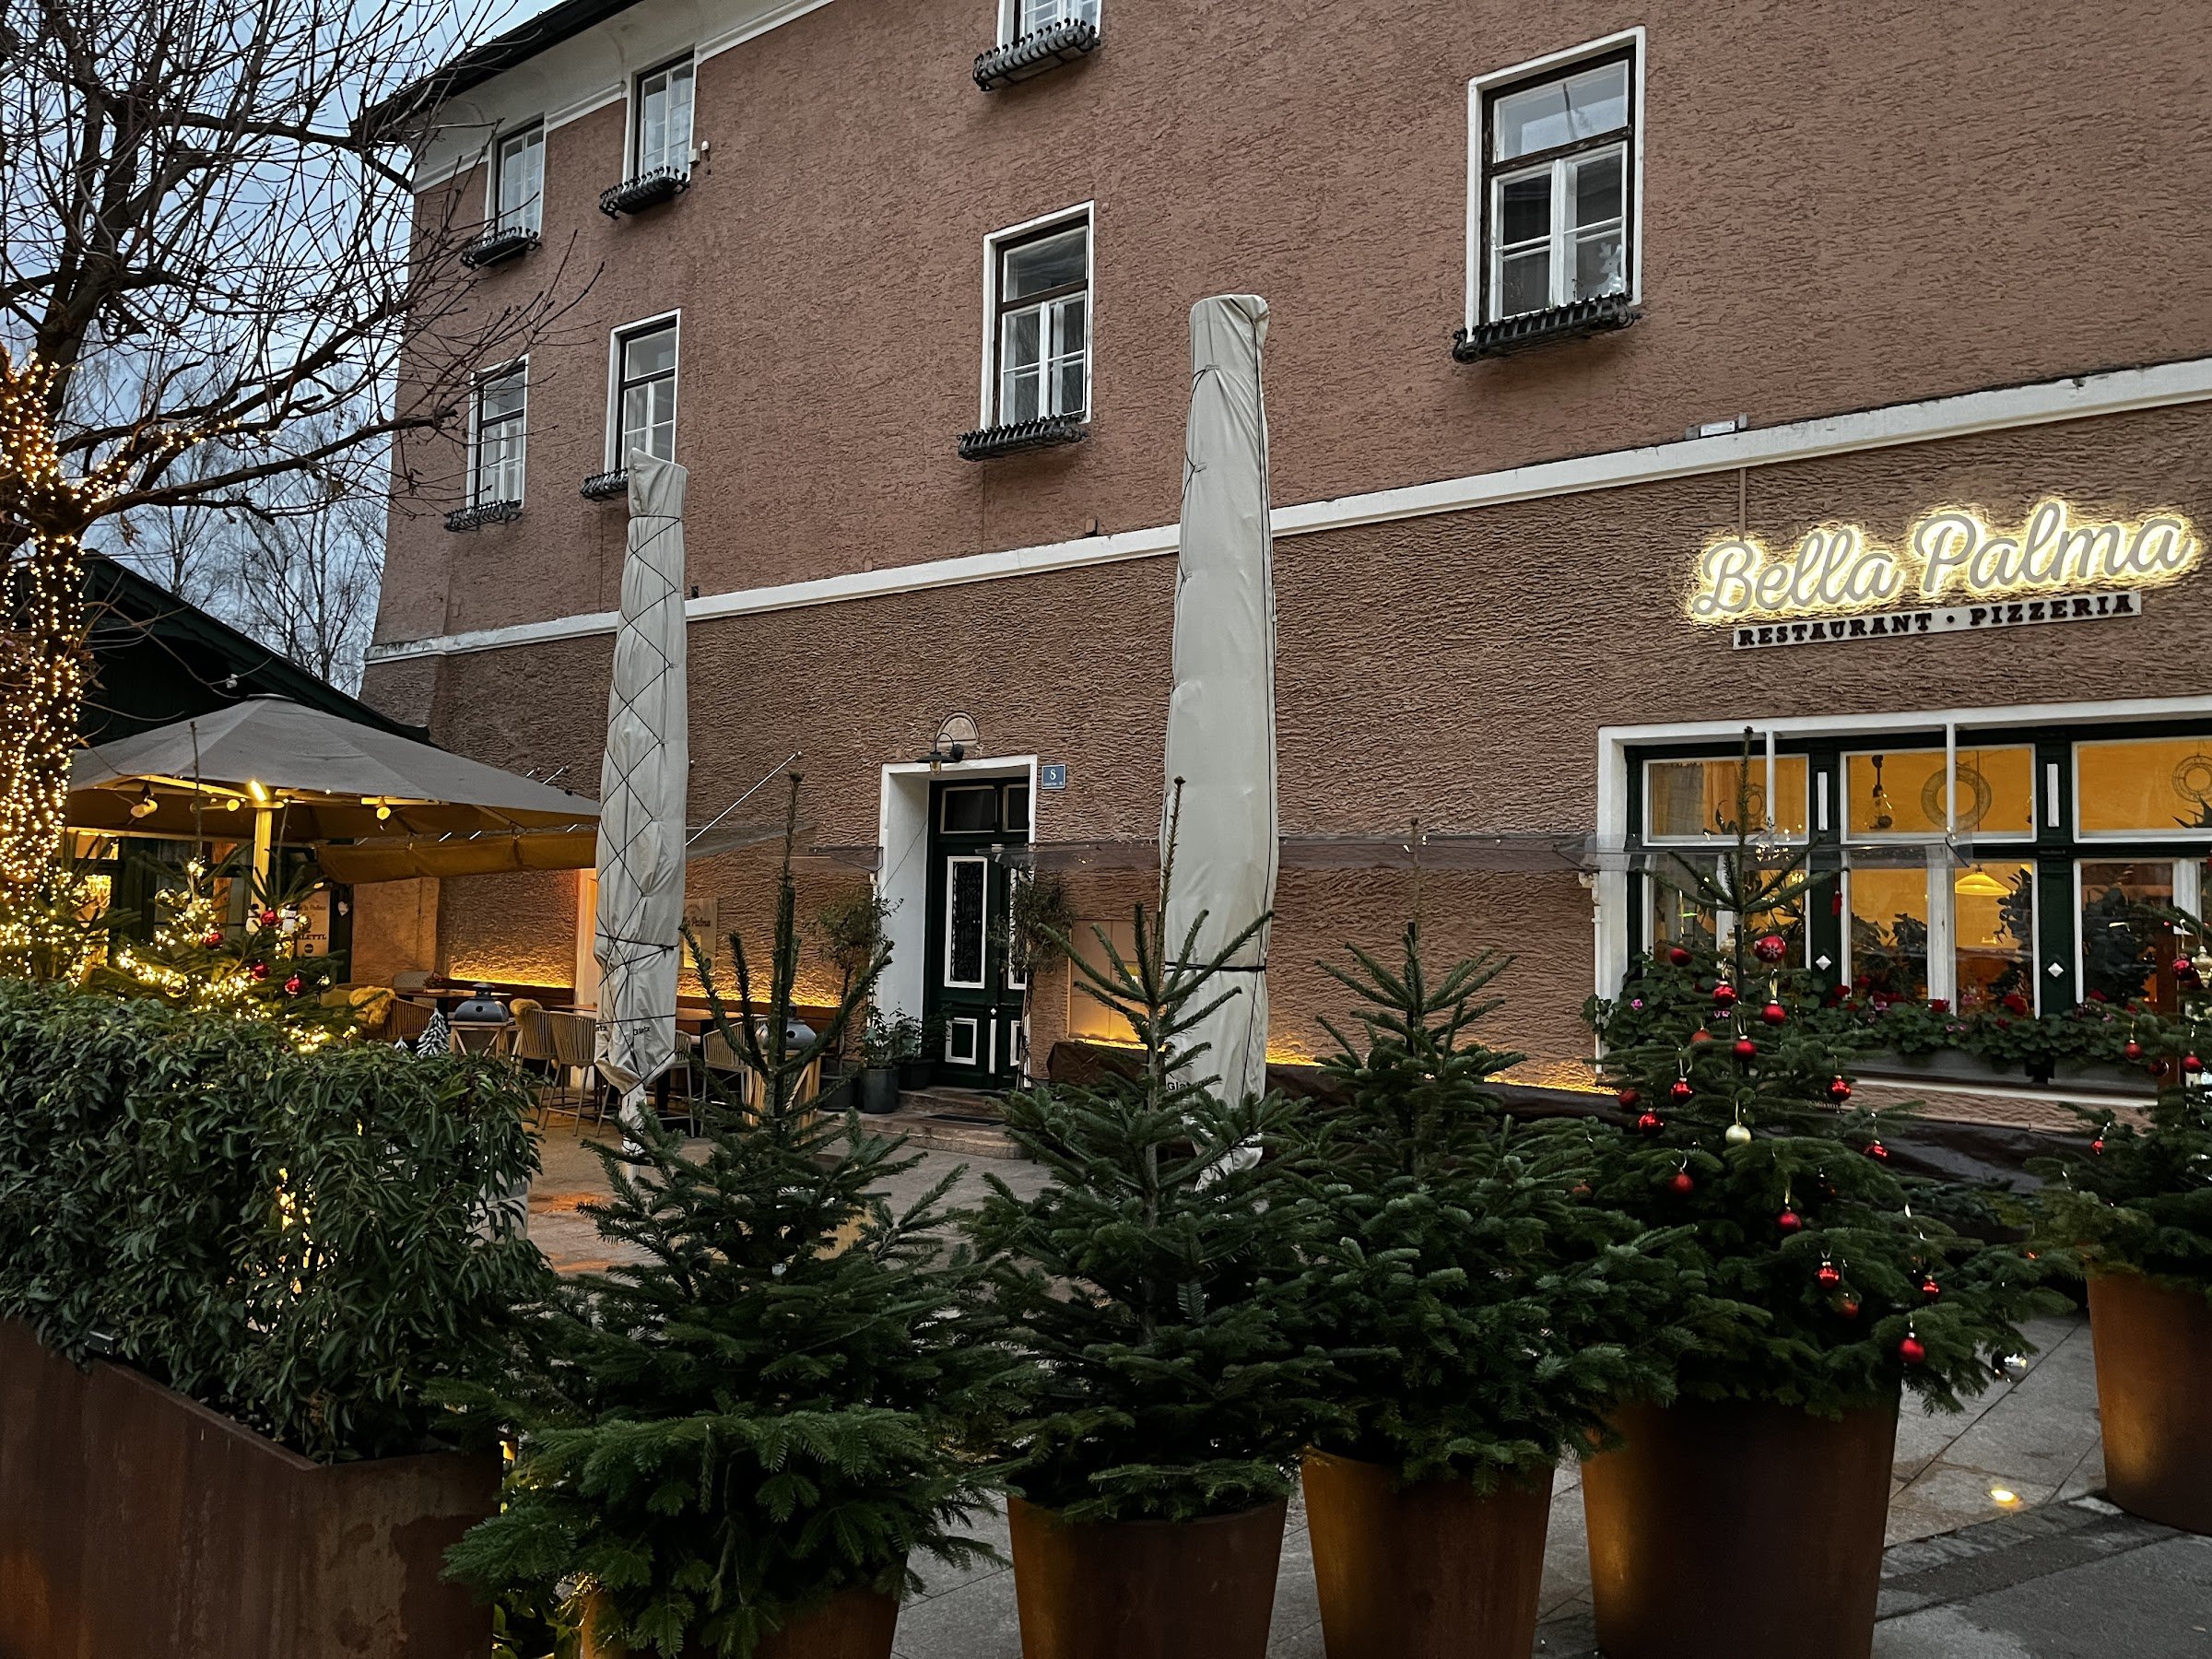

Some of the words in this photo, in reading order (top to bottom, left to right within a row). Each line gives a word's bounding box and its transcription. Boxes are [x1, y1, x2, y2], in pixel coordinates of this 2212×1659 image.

[1692, 527, 1902, 615] Bella
[1913, 502, 2191, 593] Palma
[1737, 612, 1932, 646] RESTAURANT
[1969, 594, 2134, 627] PIZZERIA
